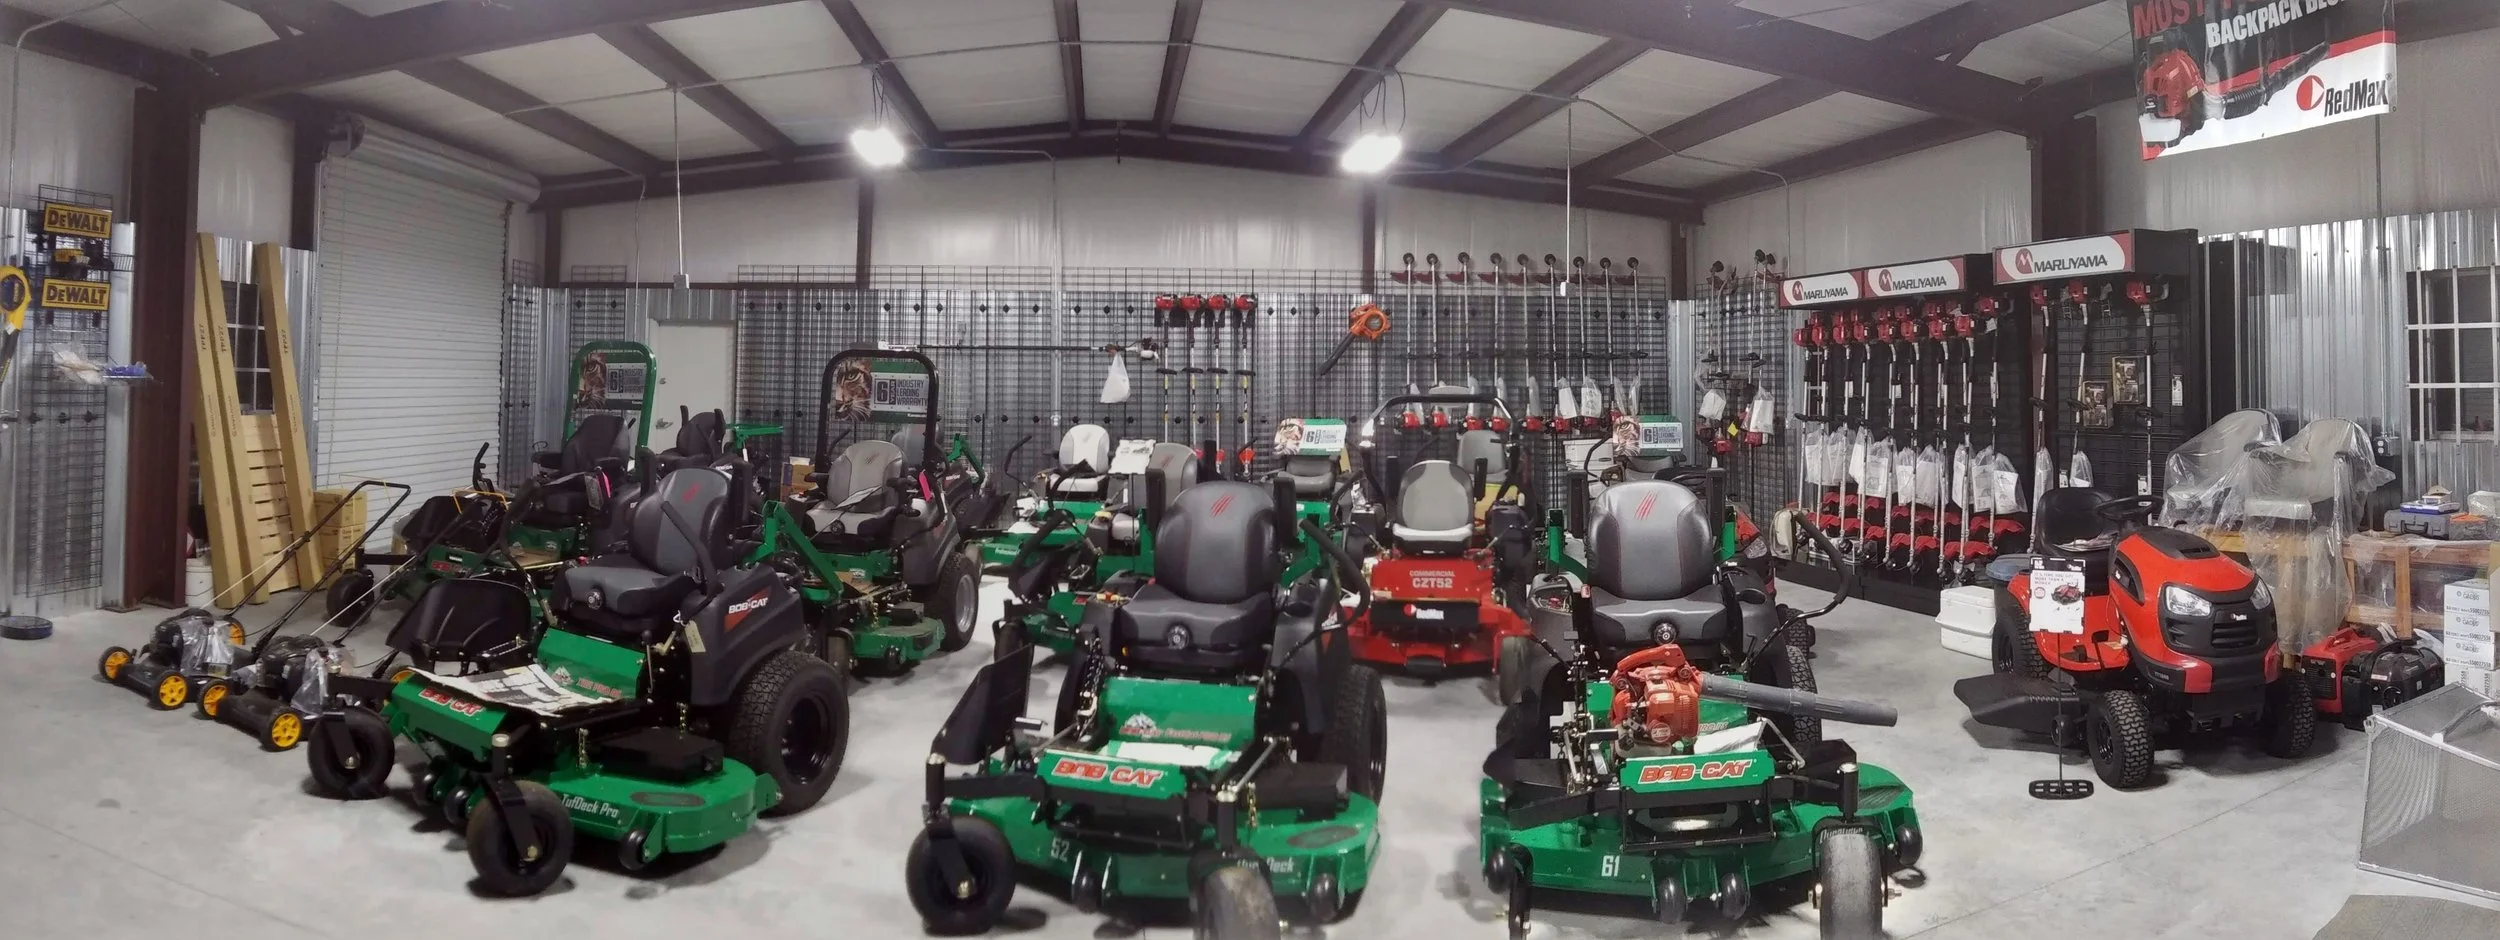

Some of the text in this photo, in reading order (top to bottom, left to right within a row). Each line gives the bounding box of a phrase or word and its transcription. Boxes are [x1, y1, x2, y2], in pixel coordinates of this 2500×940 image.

[2206, 0, 2303, 48] BACKPACK
[2324, 78, 2388, 117] RedMax
[2034, 254, 2108, 273] MARUYAMA
[1892, 276, 1947, 290] MARUYAMA
[1803, 287, 1849, 300] MARUYAMA
[876, 381, 888, 402] 6
[896, 380, 924, 388] INDUSTRY
[896, 389, 920, 397] LEADING
[1306, 431, 1315, 442] 6
[1644, 428, 1652, 442] 6
[1412, 578, 1453, 588] CZT52
[1638, 759, 1752, 784] BOB-CAT
[561, 793, 619, 818] TufDeck Pro
[1051, 837, 1070, 862] 52
[1601, 855, 1620, 877] 61
